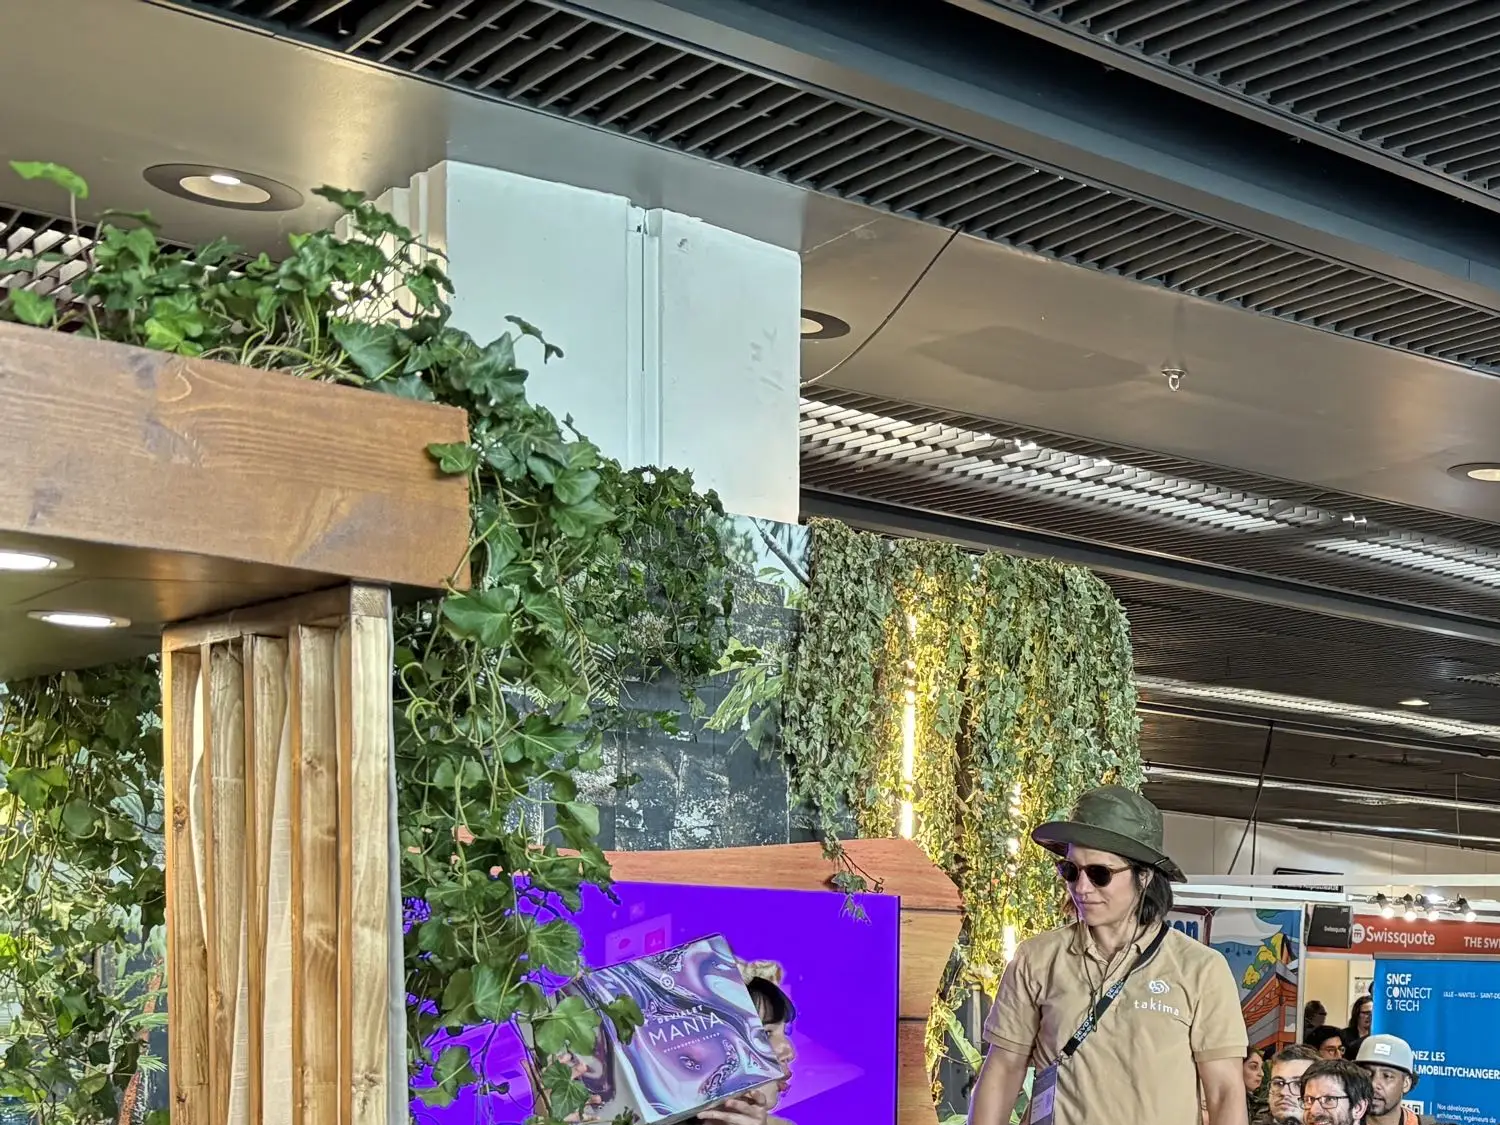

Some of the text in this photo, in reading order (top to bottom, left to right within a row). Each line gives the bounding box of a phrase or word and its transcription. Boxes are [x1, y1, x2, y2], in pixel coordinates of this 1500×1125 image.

[1367, 928, 1435, 948] Swissquote
[1464, 936, 1482, 948] THE
[1386, 973, 1412, 986] SNCF
[1386, 987, 1432, 999] CONNECT
[1134, 999, 1180, 1017] takima
[1386, 1000, 1420, 1012] & TECH
[648, 1011, 724, 1046] MANIA
[1431, 1052, 1446, 1062] LES
